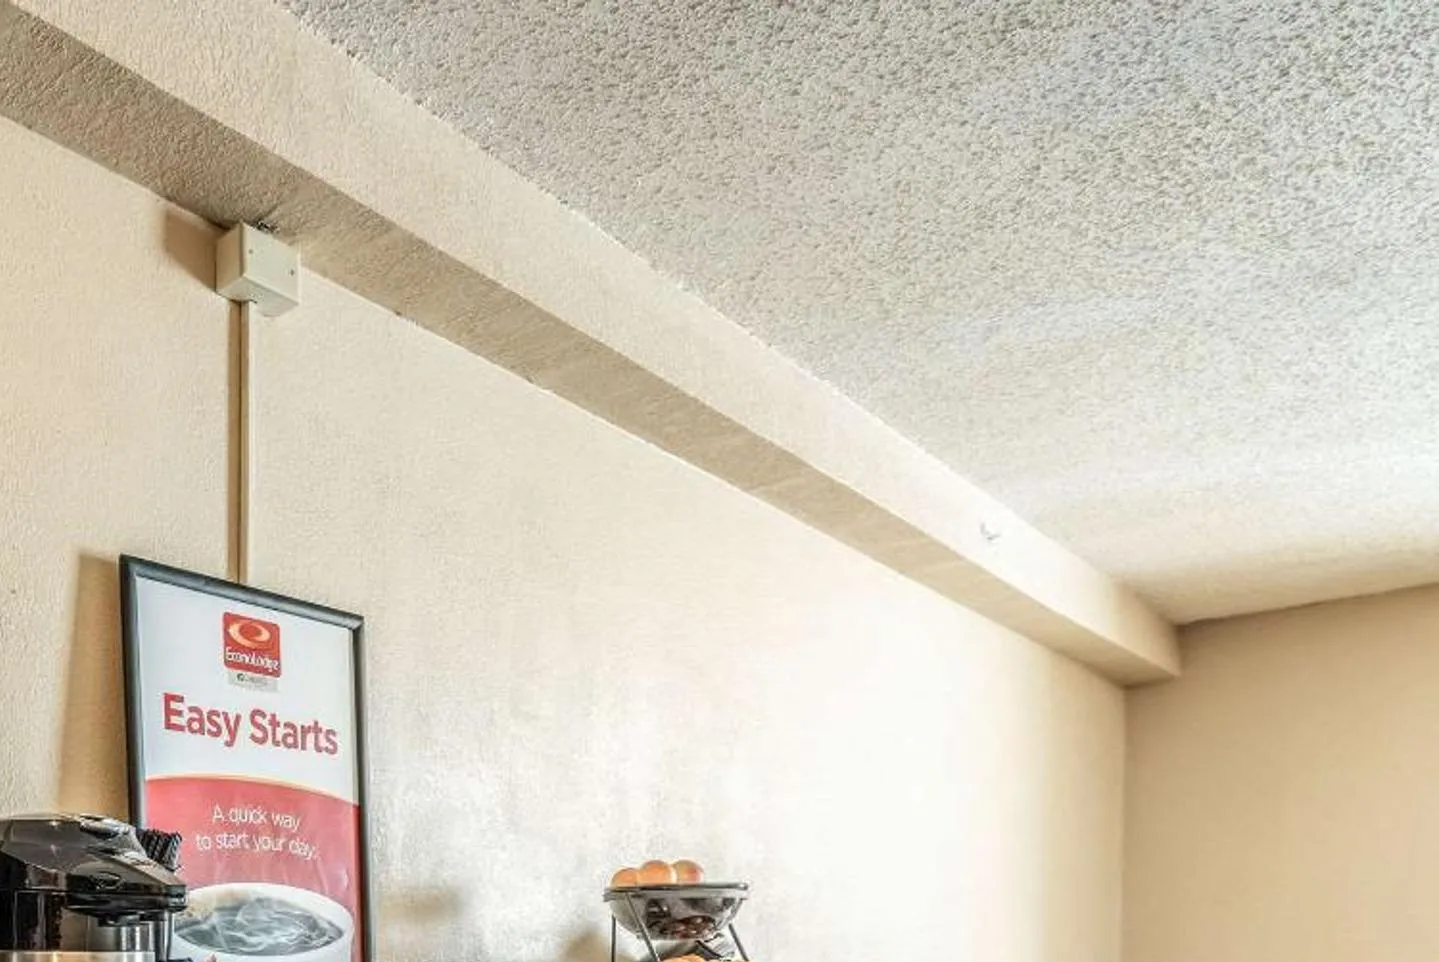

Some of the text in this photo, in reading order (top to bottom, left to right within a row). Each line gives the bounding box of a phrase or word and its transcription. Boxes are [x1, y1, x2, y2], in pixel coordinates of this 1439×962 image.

[163, 692, 338, 755] Easy Starts
[212, 803, 302, 833] A quick way
[195, 833, 212, 851] to
[215, 831, 250, 850] start
[252, 834, 286, 853] your
